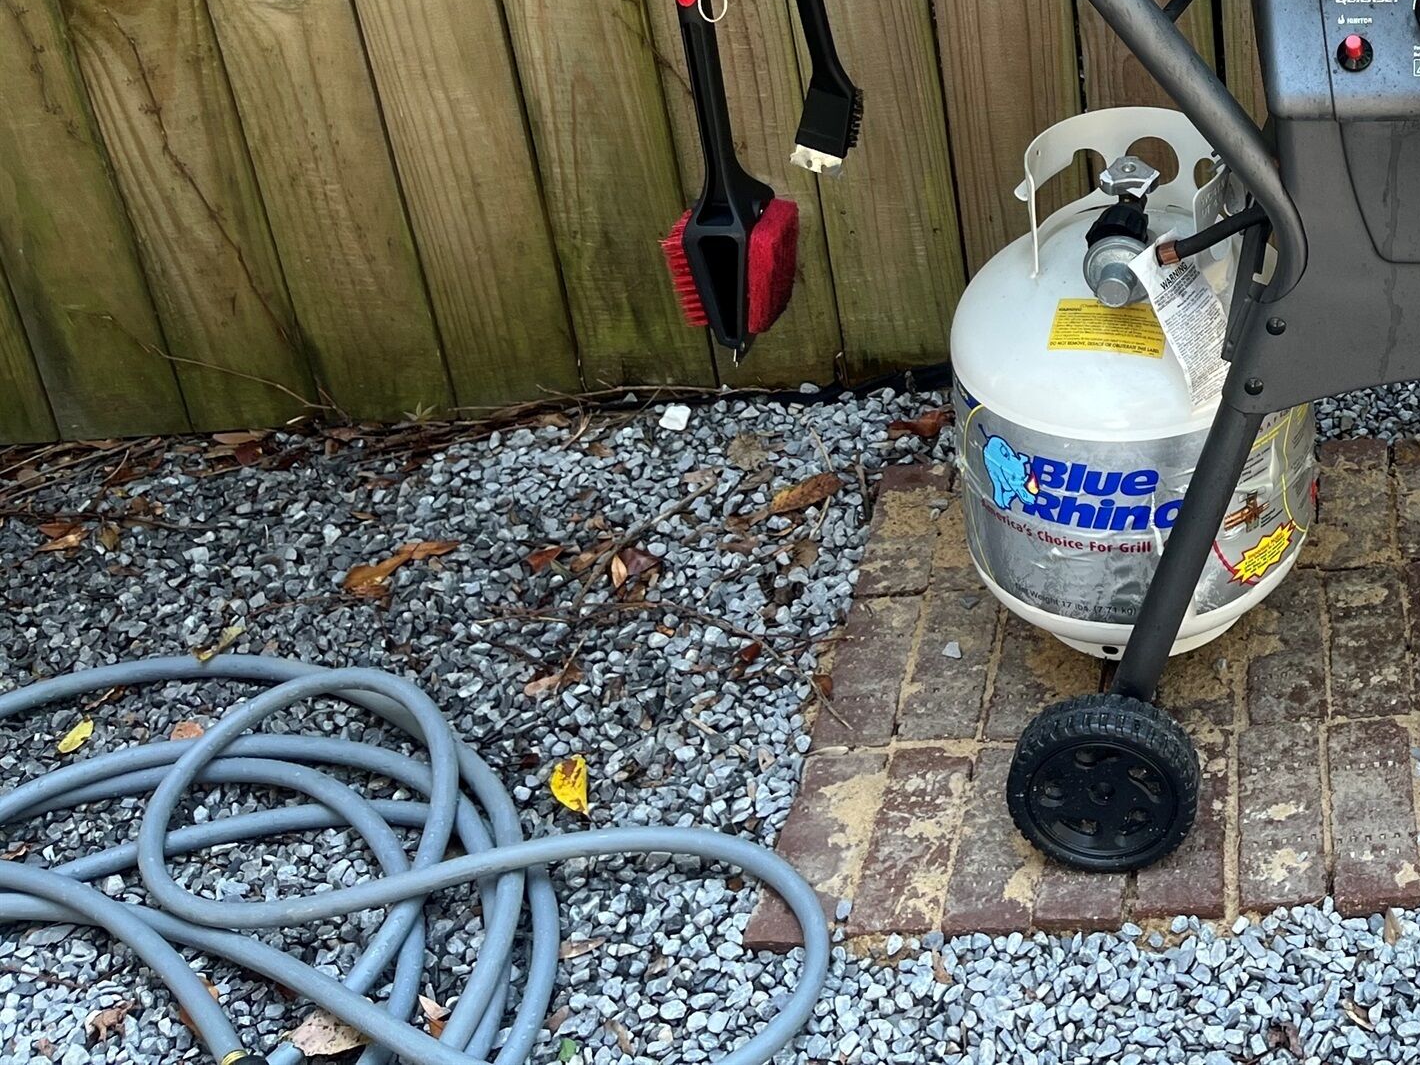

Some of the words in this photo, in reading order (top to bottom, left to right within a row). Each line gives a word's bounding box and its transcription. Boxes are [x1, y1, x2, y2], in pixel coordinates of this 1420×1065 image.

[1160, 261, 1188, 290] WARNING
[1032, 455, 1159, 497] Blue
[1022, 491, 1184, 531] Rhino
[1037, 530, 1084, 550] Choice
[1089, 541, 1116, 553] For
[1119, 541, 1152, 553] Grill
[1030, 588, 1059, 605] Weight
